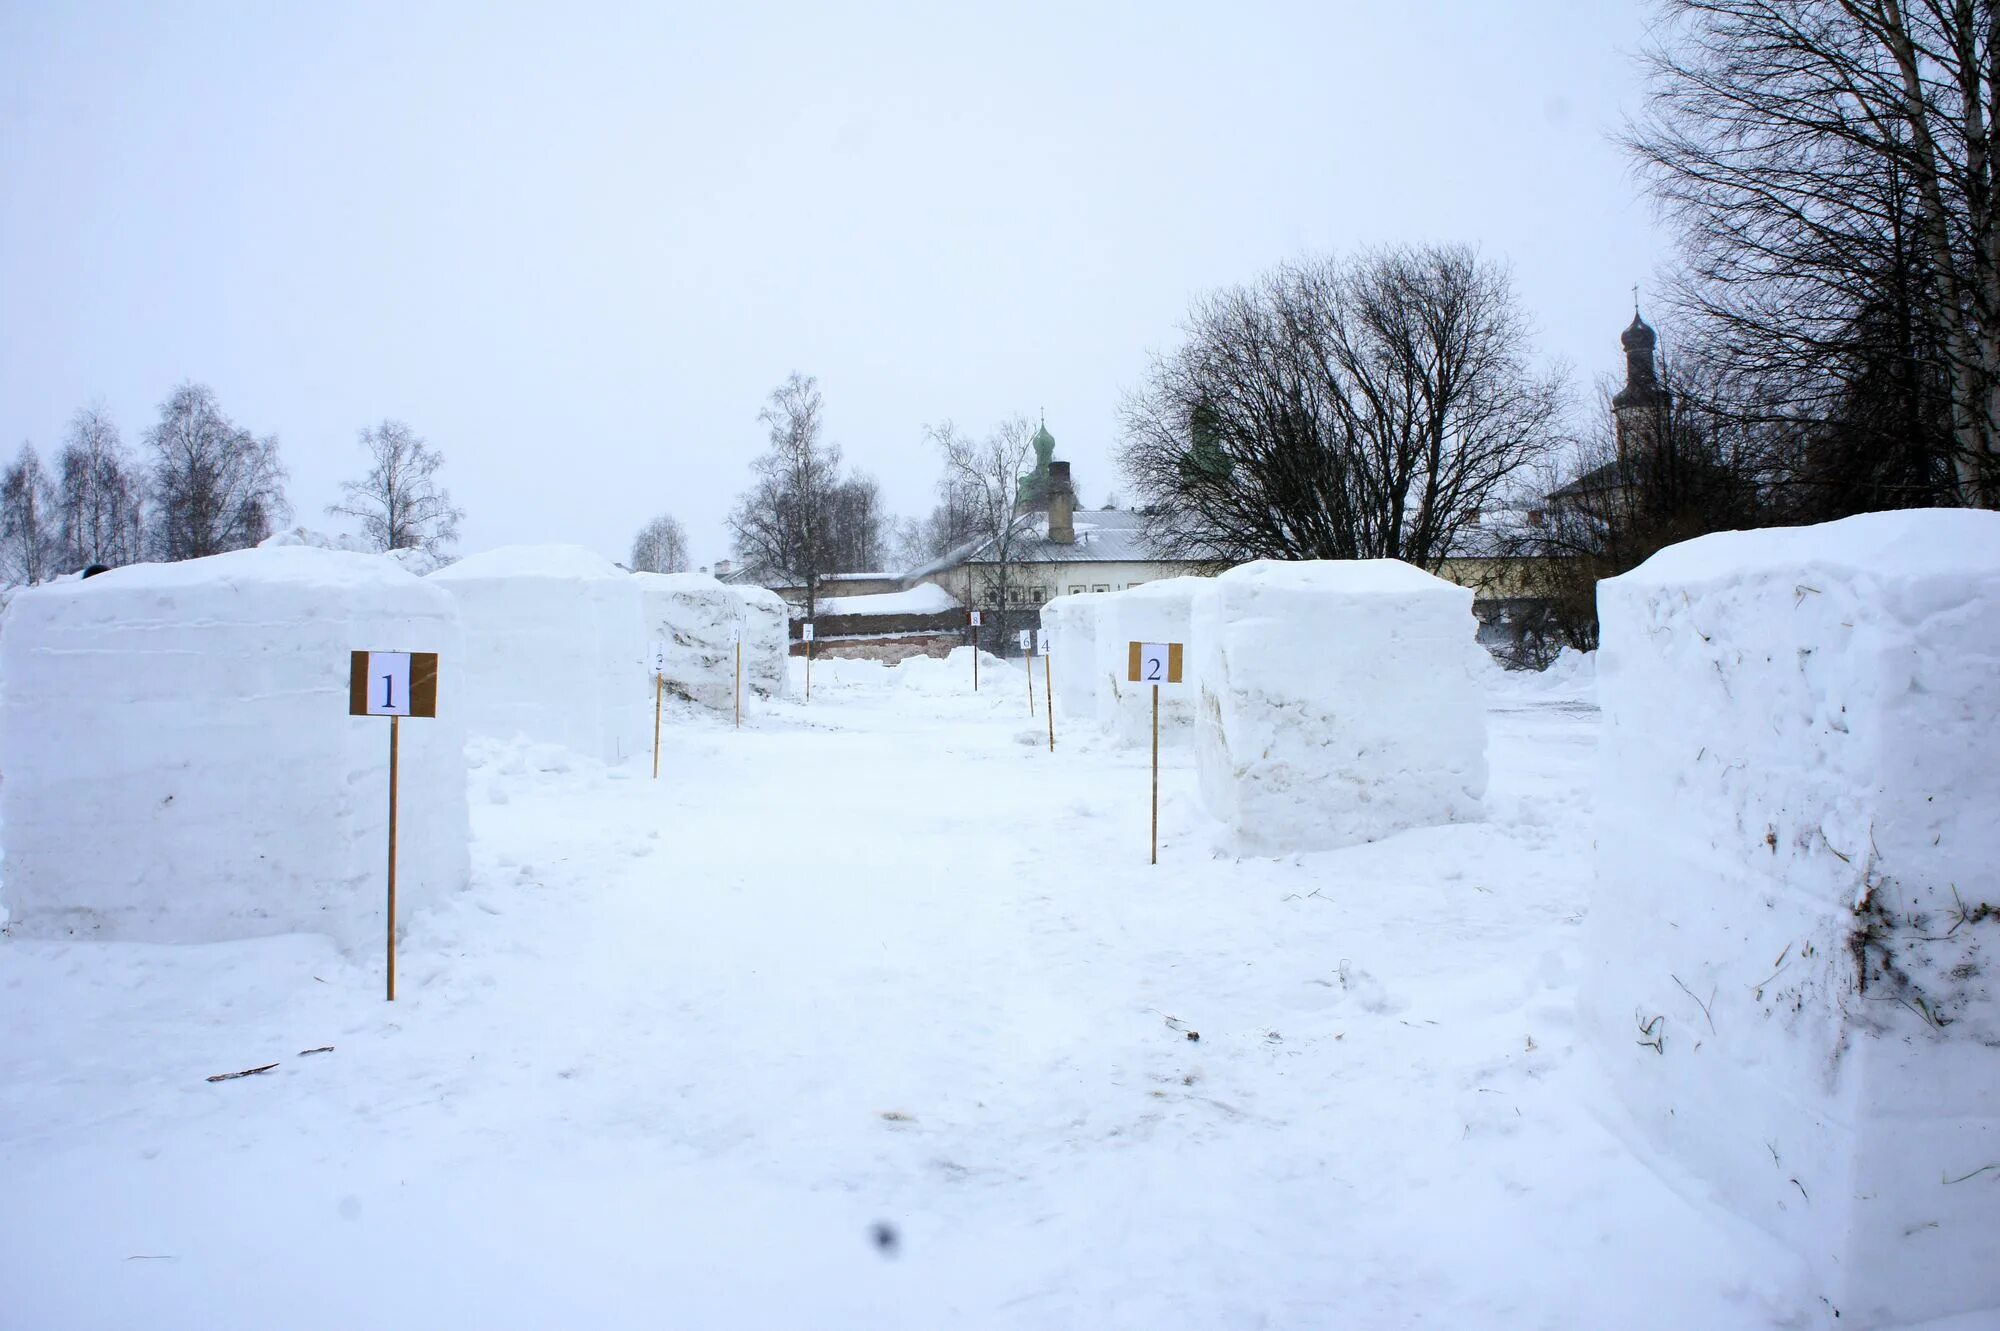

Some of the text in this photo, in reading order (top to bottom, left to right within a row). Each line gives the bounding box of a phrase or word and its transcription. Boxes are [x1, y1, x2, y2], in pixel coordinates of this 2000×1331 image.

[805, 629, 811, 639] 7
[1023, 637, 1030, 648] 6
[1041, 639, 1050, 652] 4
[1147, 658, 1161, 680] 2
[381, 674, 396, 708] 1
